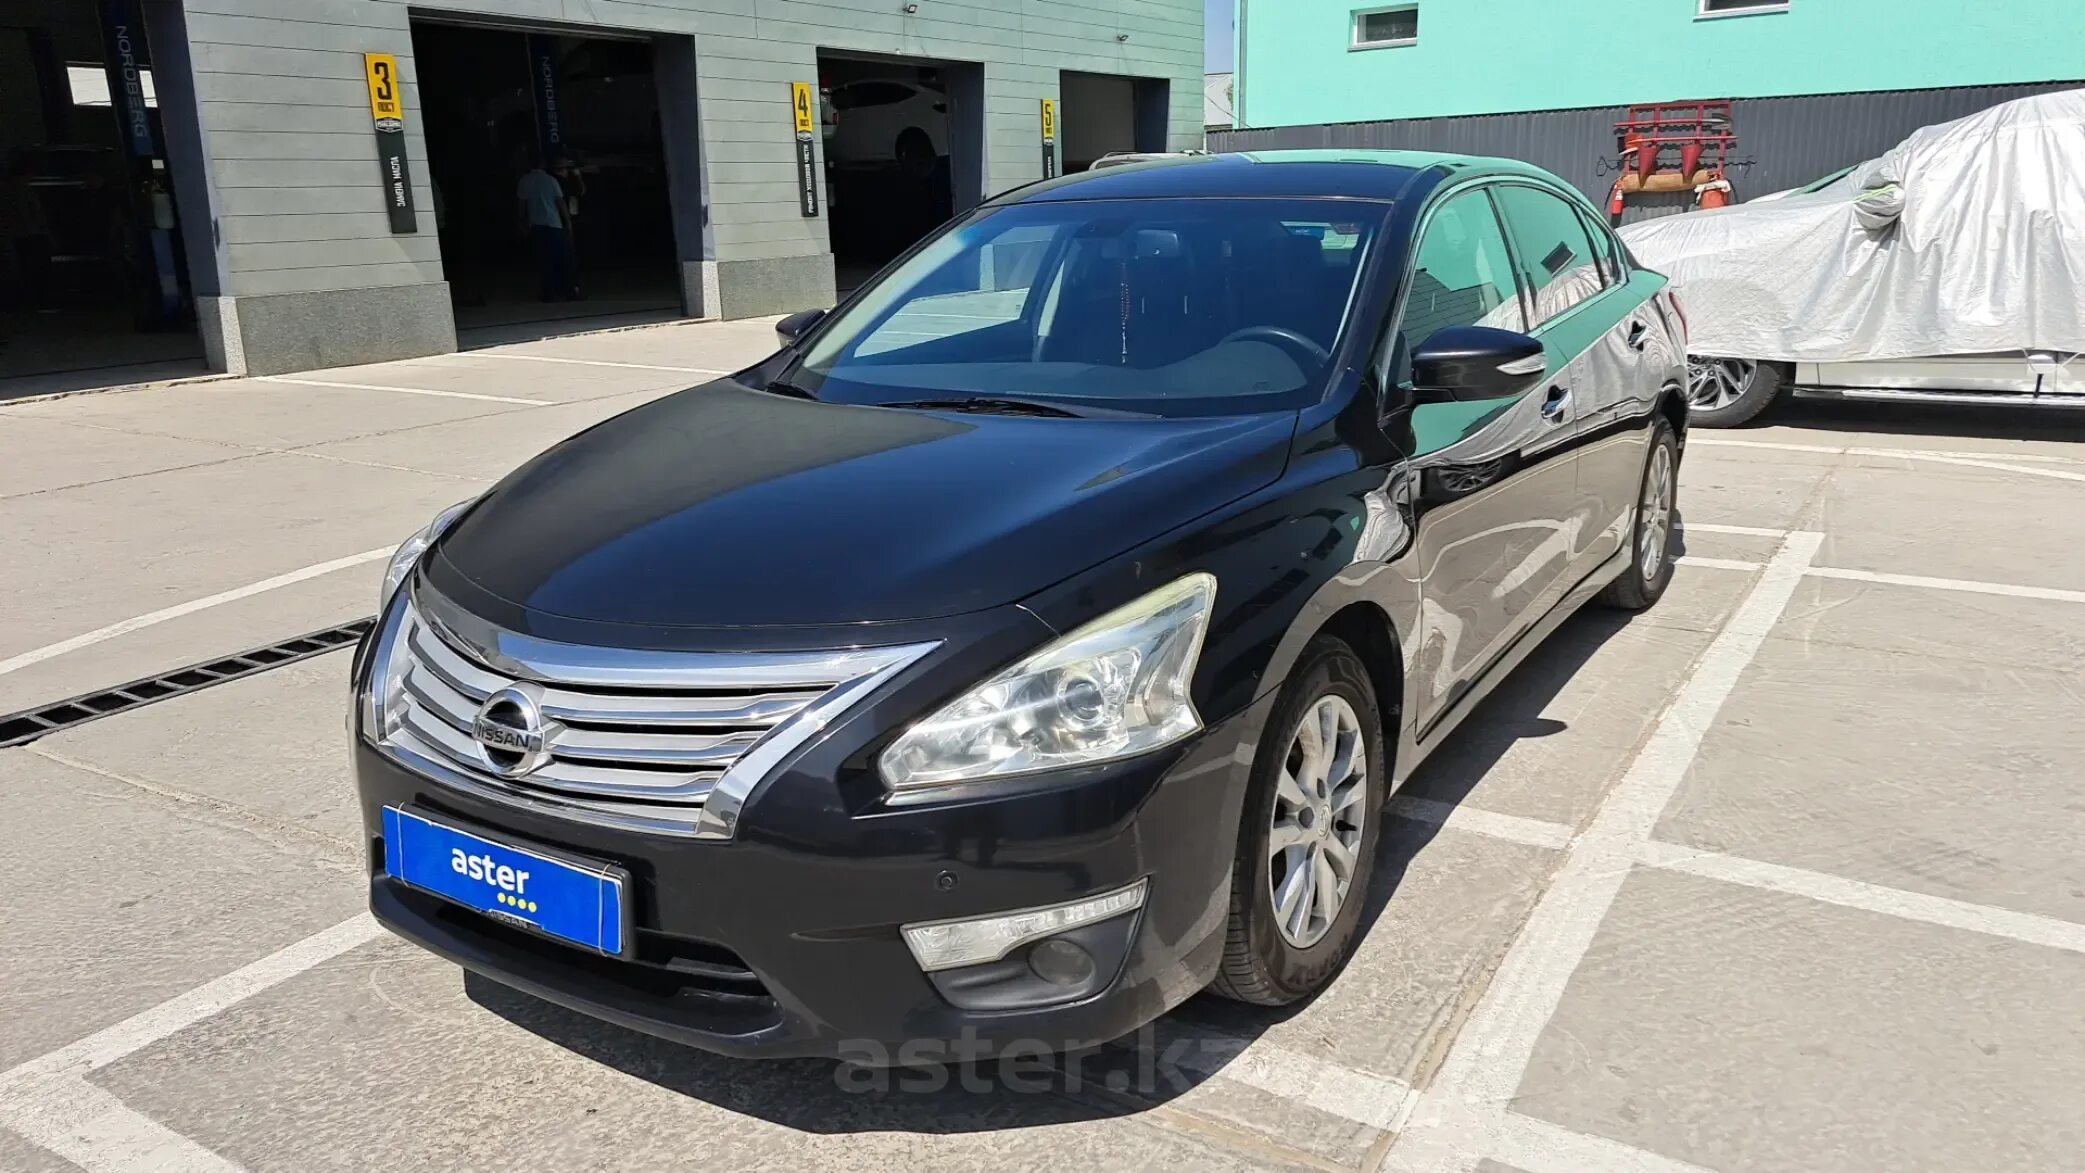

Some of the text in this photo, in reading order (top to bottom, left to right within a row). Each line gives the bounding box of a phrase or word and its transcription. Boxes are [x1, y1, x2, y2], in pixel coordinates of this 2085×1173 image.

[115, 25, 148, 138] NORDBERG
[374, 61, 392, 100] 3
[541, 56, 560, 144] NORDBERG
[798, 88, 808, 117] 4
[1044, 103, 1052, 126] 5
[390, 155, 406, 207] ЗАМЕНА МАСЛА
[473, 721, 529, 748] NISSAN
[451, 848, 530, 894] aster
